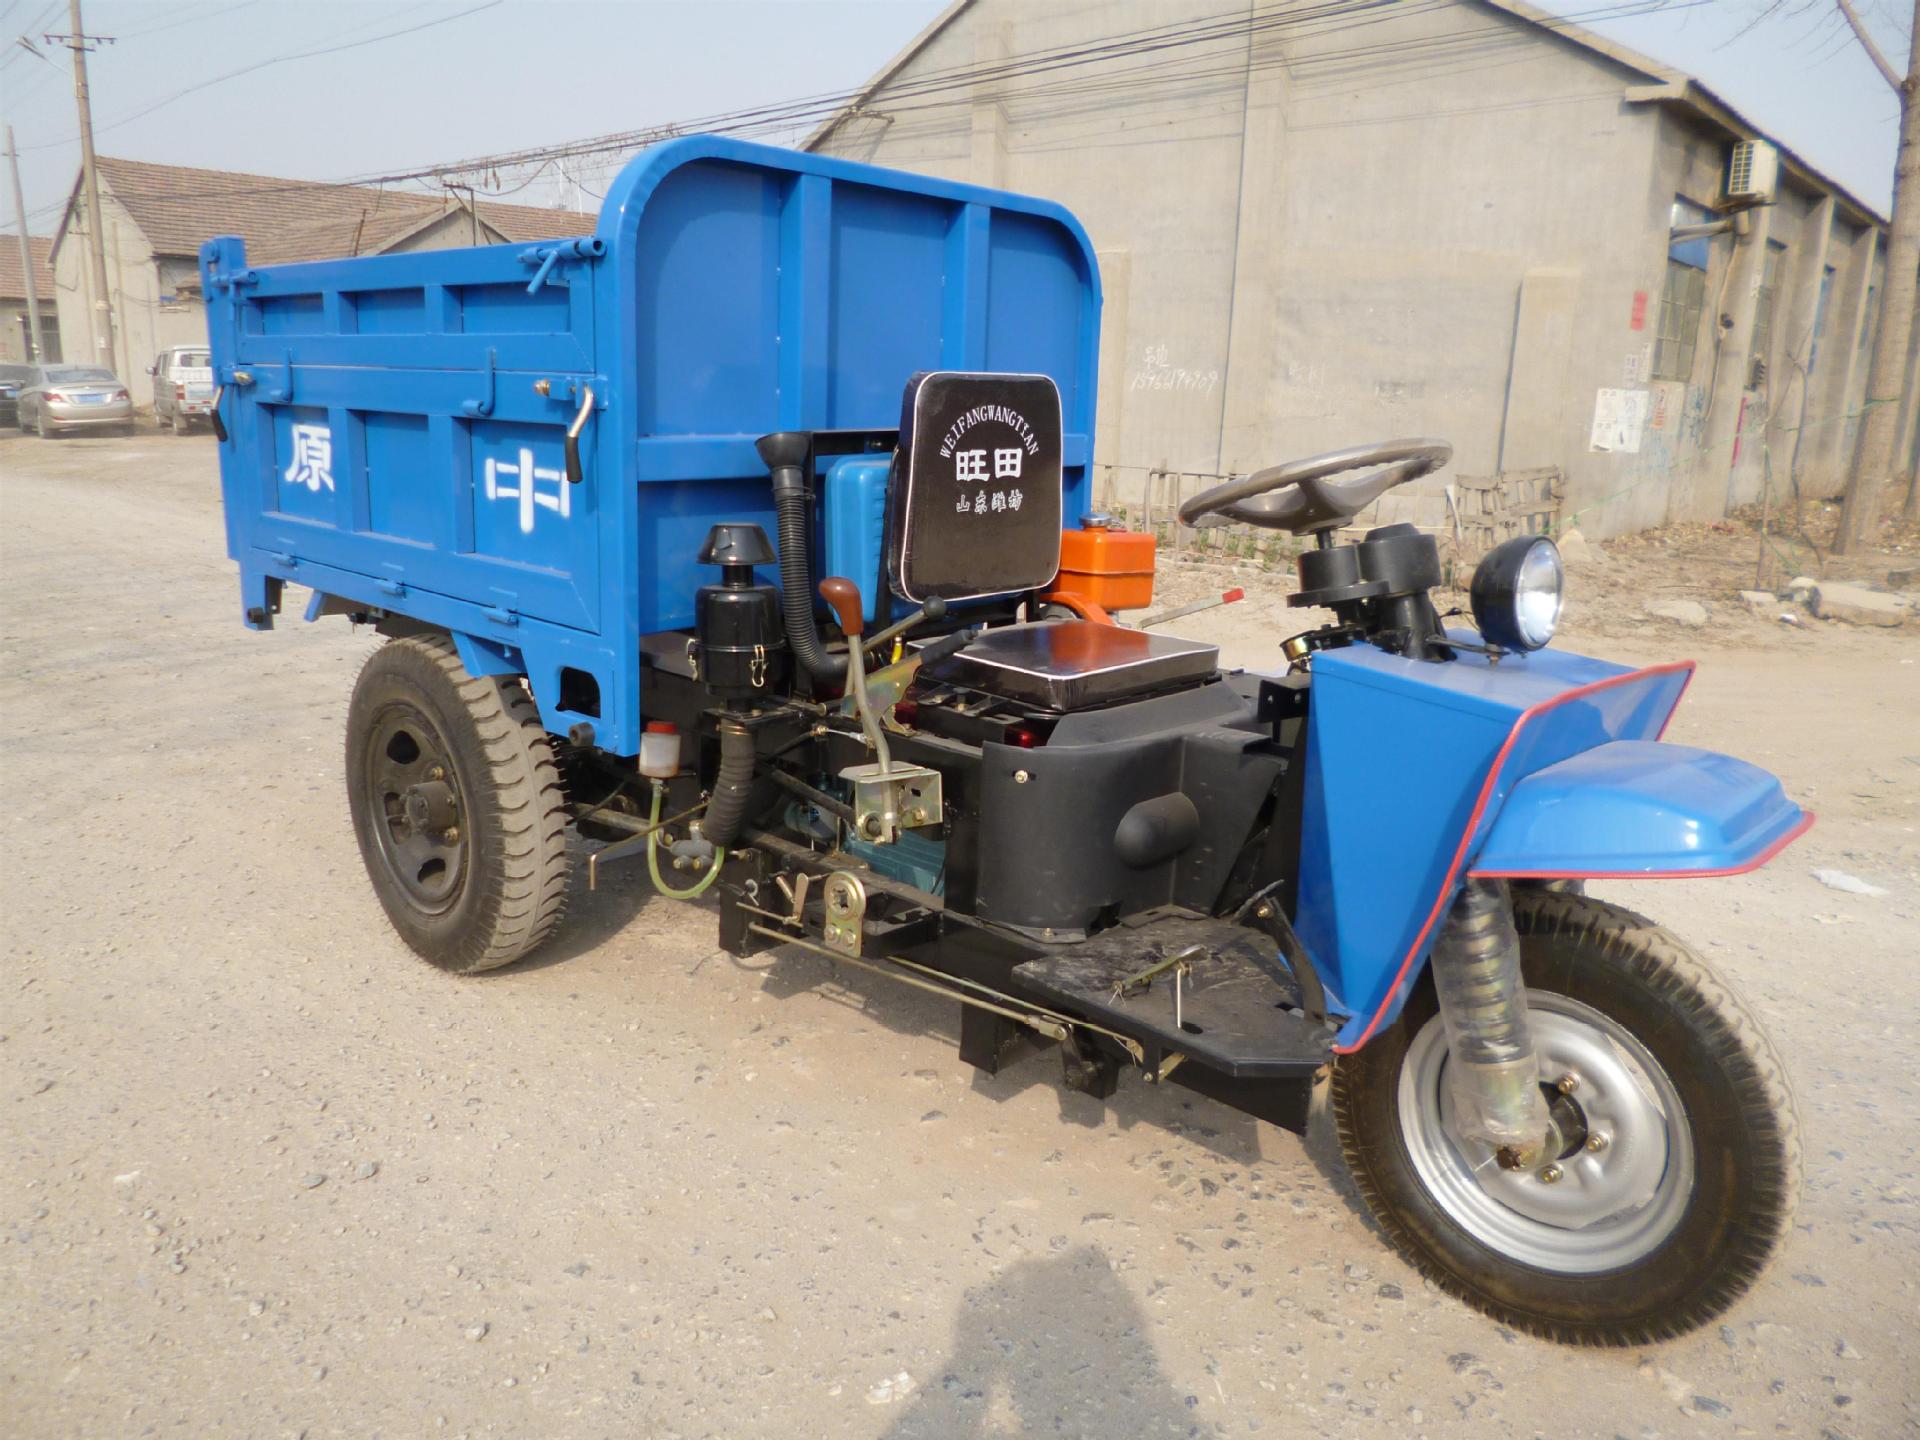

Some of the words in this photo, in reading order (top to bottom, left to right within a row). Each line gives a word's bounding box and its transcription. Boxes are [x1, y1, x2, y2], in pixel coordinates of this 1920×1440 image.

[285, 423, 334, 492] 原
[940, 404, 1038, 459] WEIFANGWANGTIAN
[485, 448, 570, 533] 中
[955, 448, 1022, 481] 旺田
